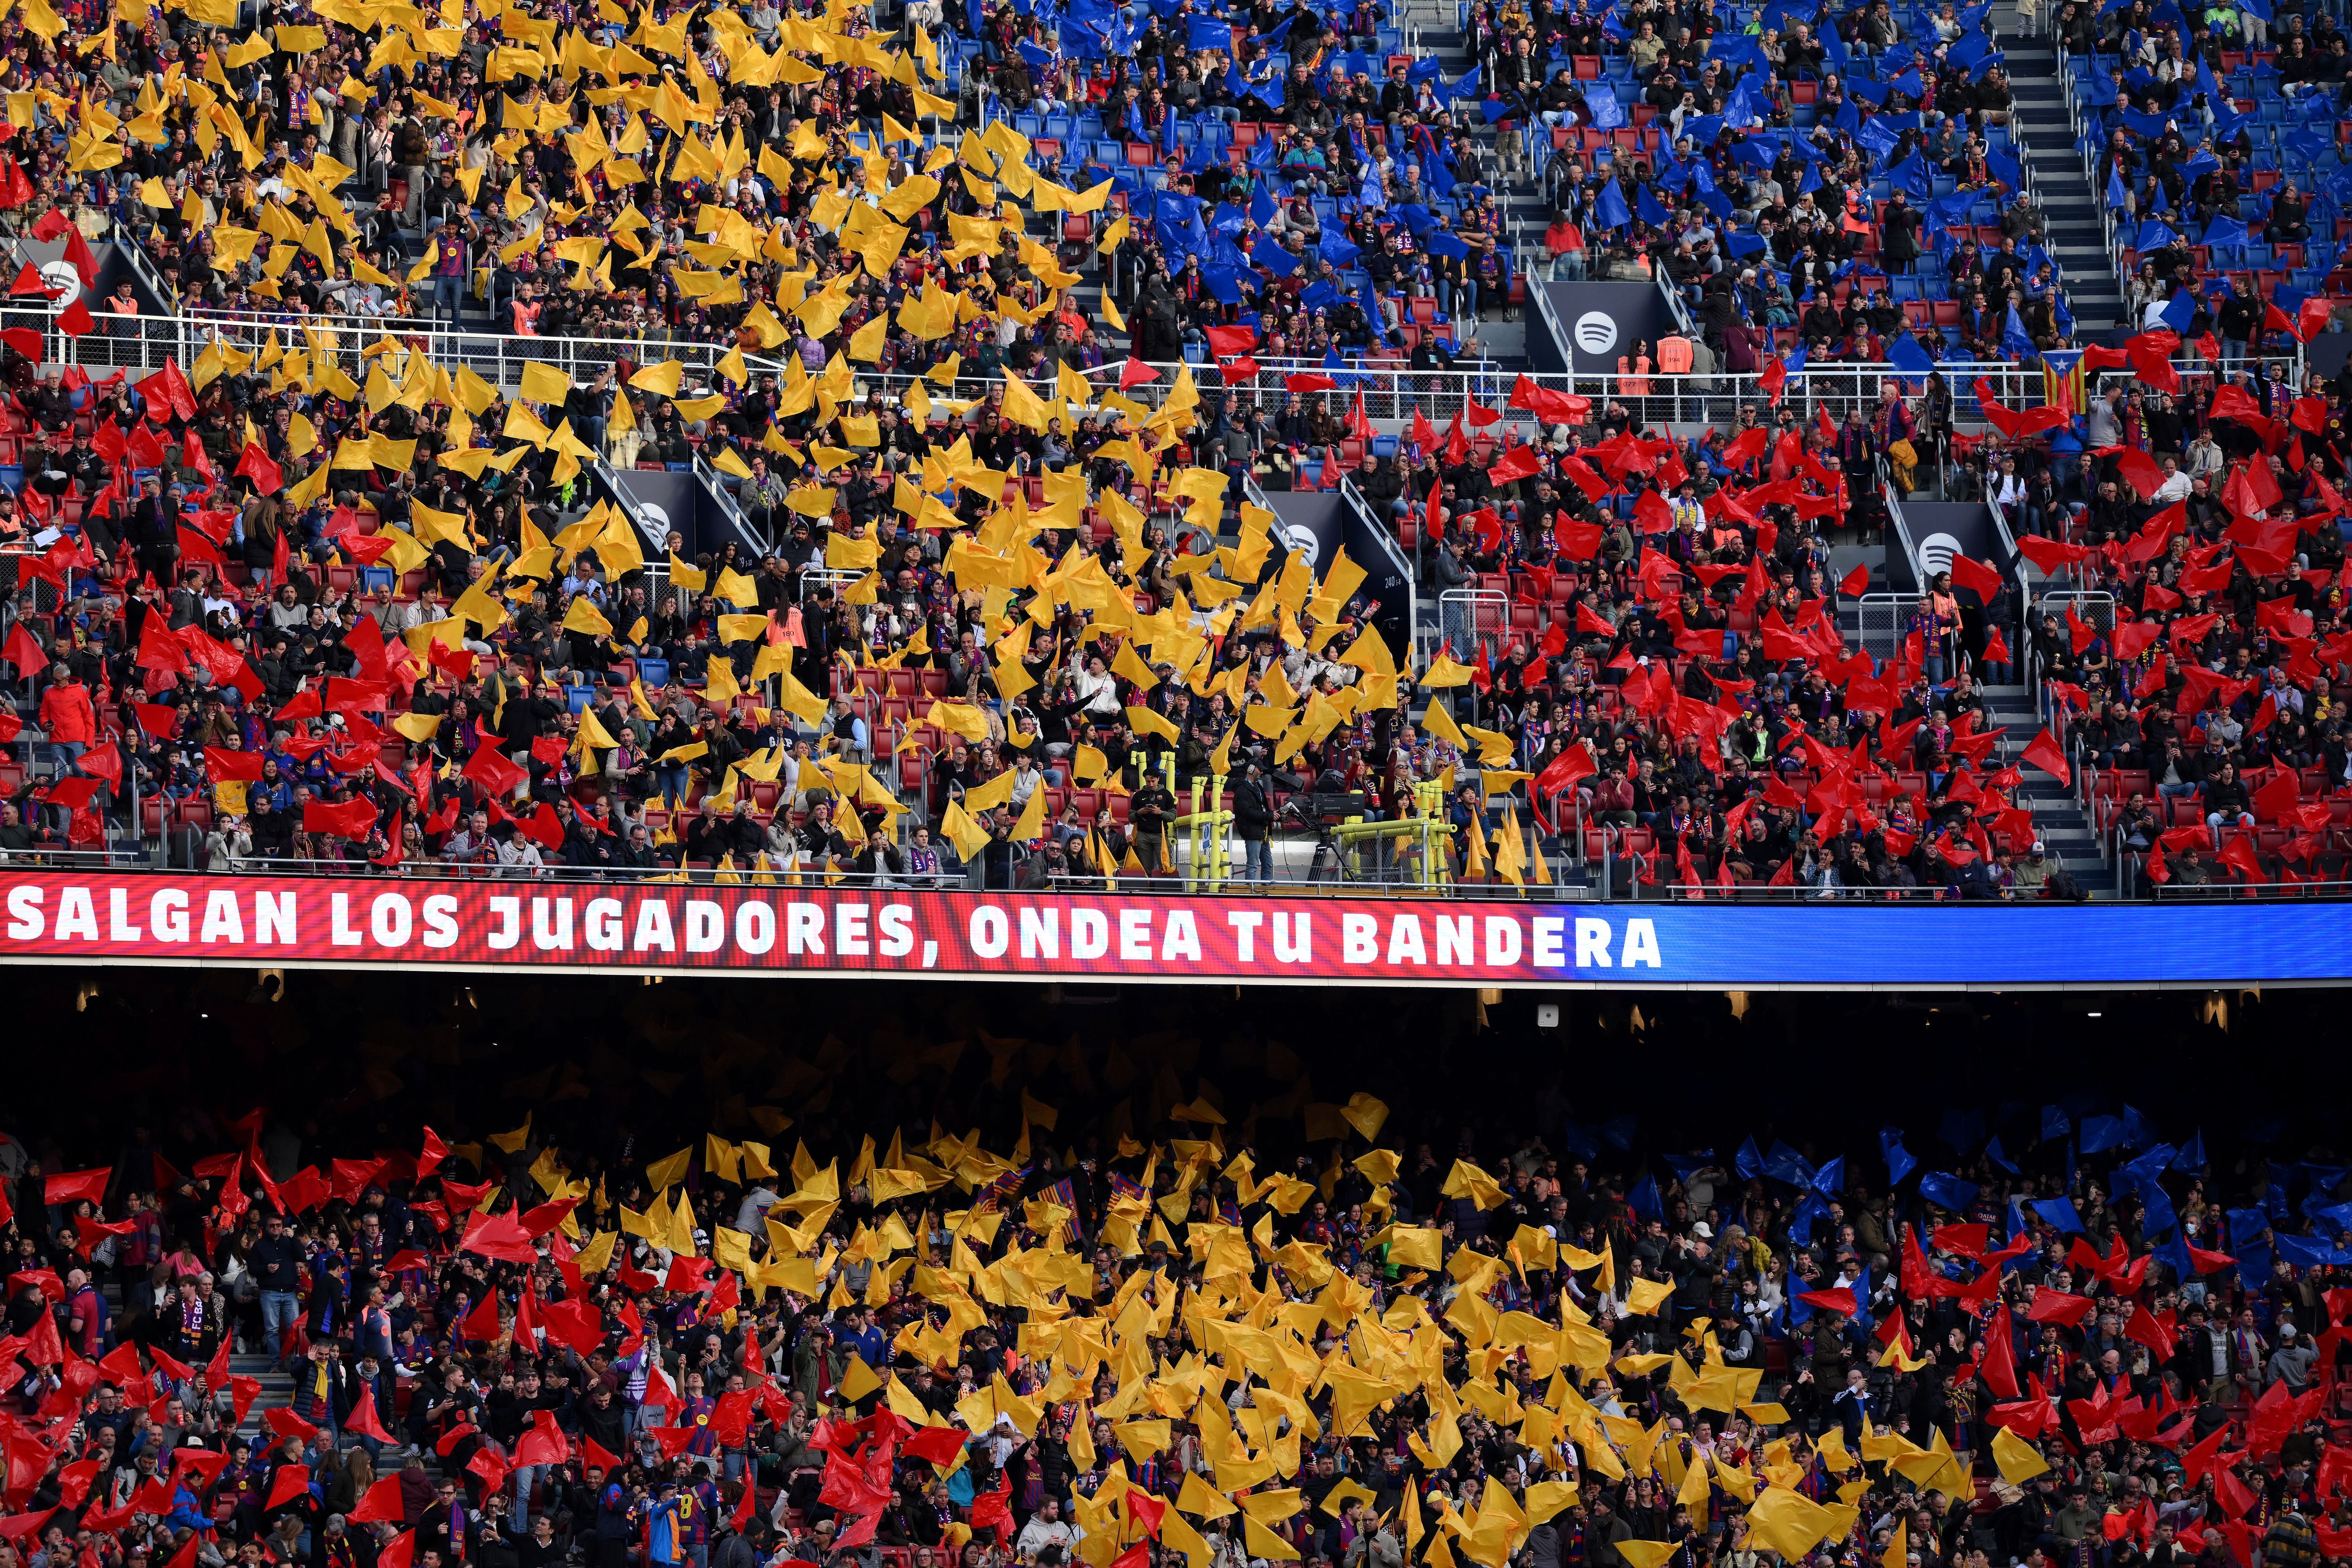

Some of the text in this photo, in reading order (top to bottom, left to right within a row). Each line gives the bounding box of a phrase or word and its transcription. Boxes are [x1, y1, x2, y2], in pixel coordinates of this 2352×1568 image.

[2270, 381, 2279, 398] ONA
[1385, 575, 1395, 589] 240
[1365, 778, 1376, 793] LON
[8, 886, 1661, 967] SALGAN LOS JUGADORES, ONDEA TU BANDERA
[681, 1494, 693, 1519] 8
